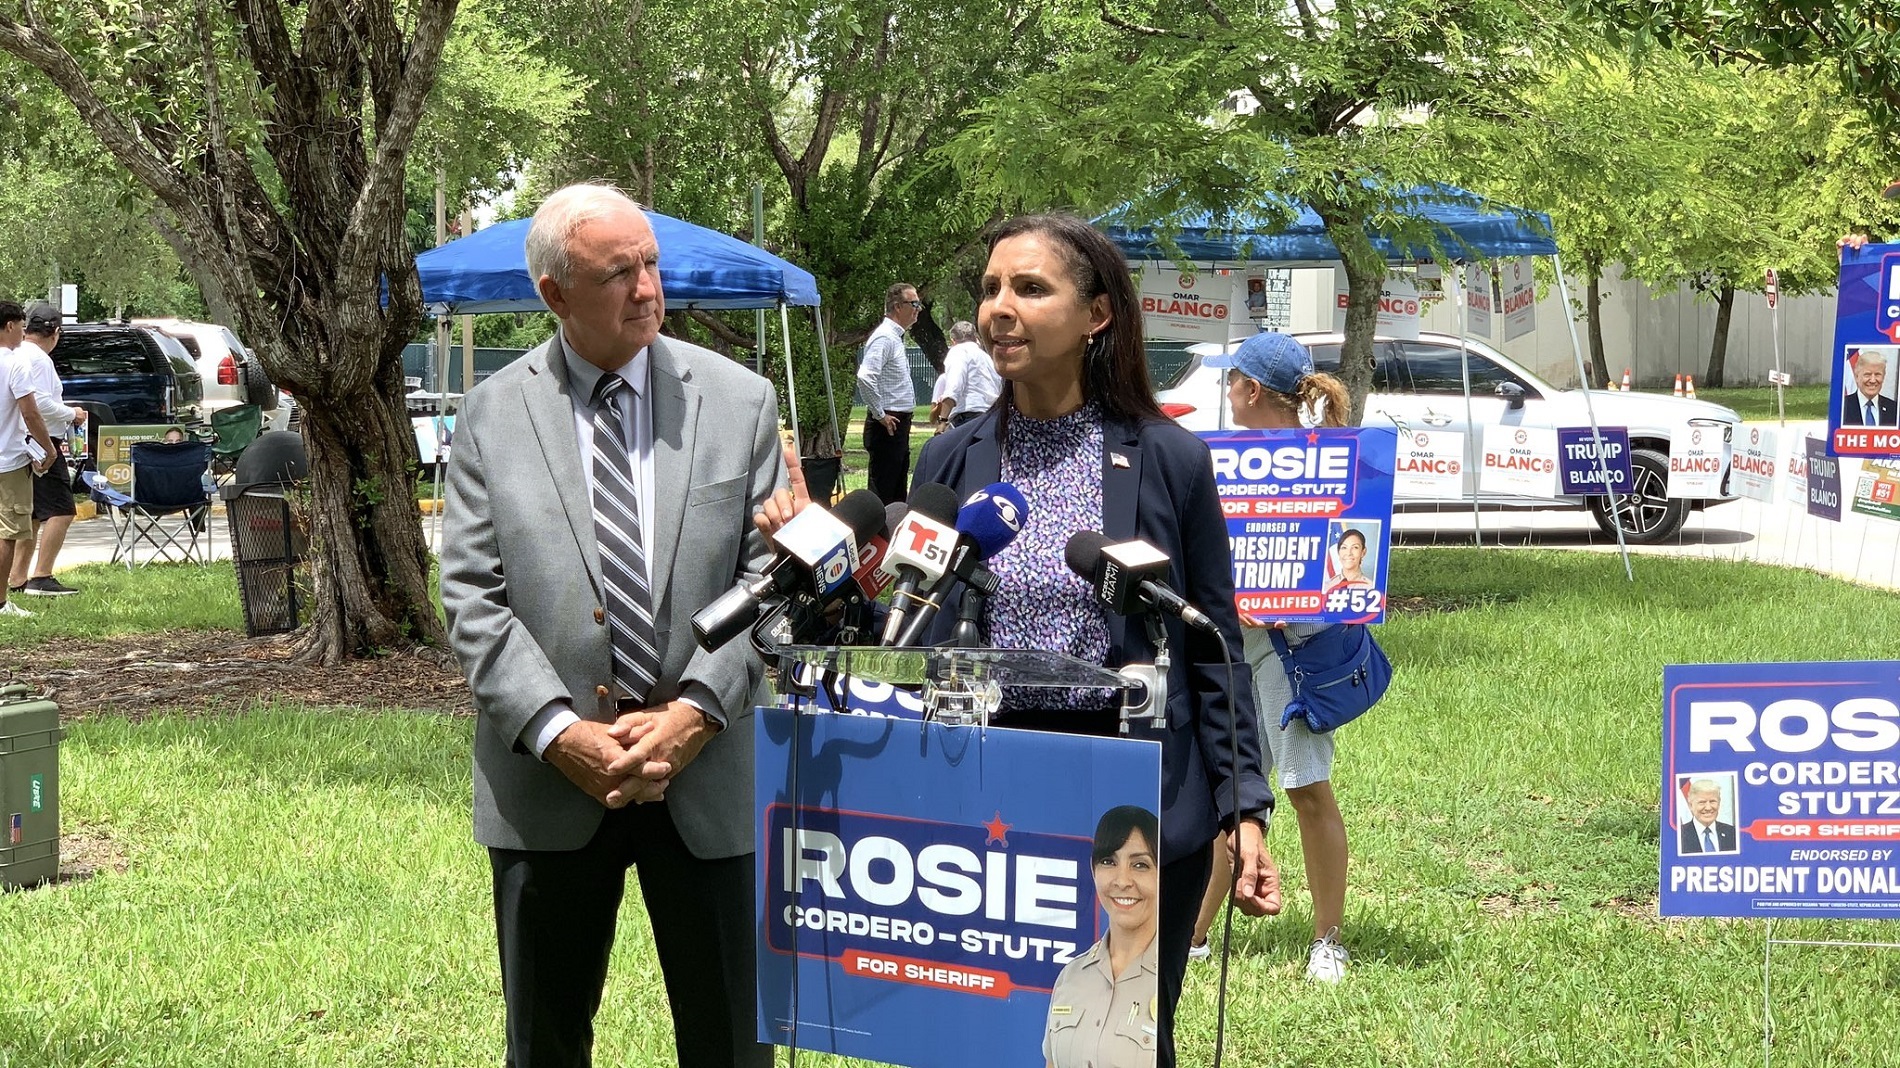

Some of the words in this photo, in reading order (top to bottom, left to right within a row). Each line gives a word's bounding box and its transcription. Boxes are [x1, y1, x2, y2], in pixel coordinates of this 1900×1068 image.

[1173, 292, 1200, 301] OMAR
[1337, 294, 1418, 315] BNCO
[1142, 297, 1228, 319] BLANCO
[1836, 434, 1868, 447] THE
[1410, 451, 1434, 459] OMAR
[1510, 448, 1532, 456] OMAR
[1565, 443, 1622, 460] TRUMP
[1209, 446, 1350, 480] ROSIE
[1397, 458, 1460, 475] LANCO
[1485, 453, 1554, 473] BLANCO
[1671, 457, 1720, 473] BLANCO
[1732, 453, 1774, 478] BLANCO
[1809, 457, 1836, 479] TRUMP
[1569, 470, 1625, 484] BLANCO
[1217, 483, 1347, 496] ORDERO-STUTZ
[1810, 488, 1838, 508] BLANCO
[1255, 501, 1338, 513] SHERIFF
[1245, 522, 1286, 533] ENDORSED
[1289, 522, 1301, 533] BY
[847, 542, 858, 566] Local
[924, 544, 949, 566] 51
[823, 548, 848, 584] 10
[1234, 562, 1305, 589] TRUMP
[815, 565, 827, 594] NEWS
[1106, 563, 1119, 604] MIAMI
[1239, 595, 1320, 610] QUALIFIED
[1325, 589, 1382, 613] #52
[1744, 761, 1900, 785] CORDER
[32, 780, 41, 809] LIBRE
[1778, 791, 1900, 815] STUTZ
[1766, 824, 1811, 836] FOR
[1790, 849, 1869, 861] ENDORSED
[1872, 849, 1893, 861] BY
[783, 827, 1078, 929] ROSIE
[1671, 866, 1810, 893] PRESIDENT
[856, 956, 899, 976] FOR
[904, 963, 995, 990] SHERIFF
